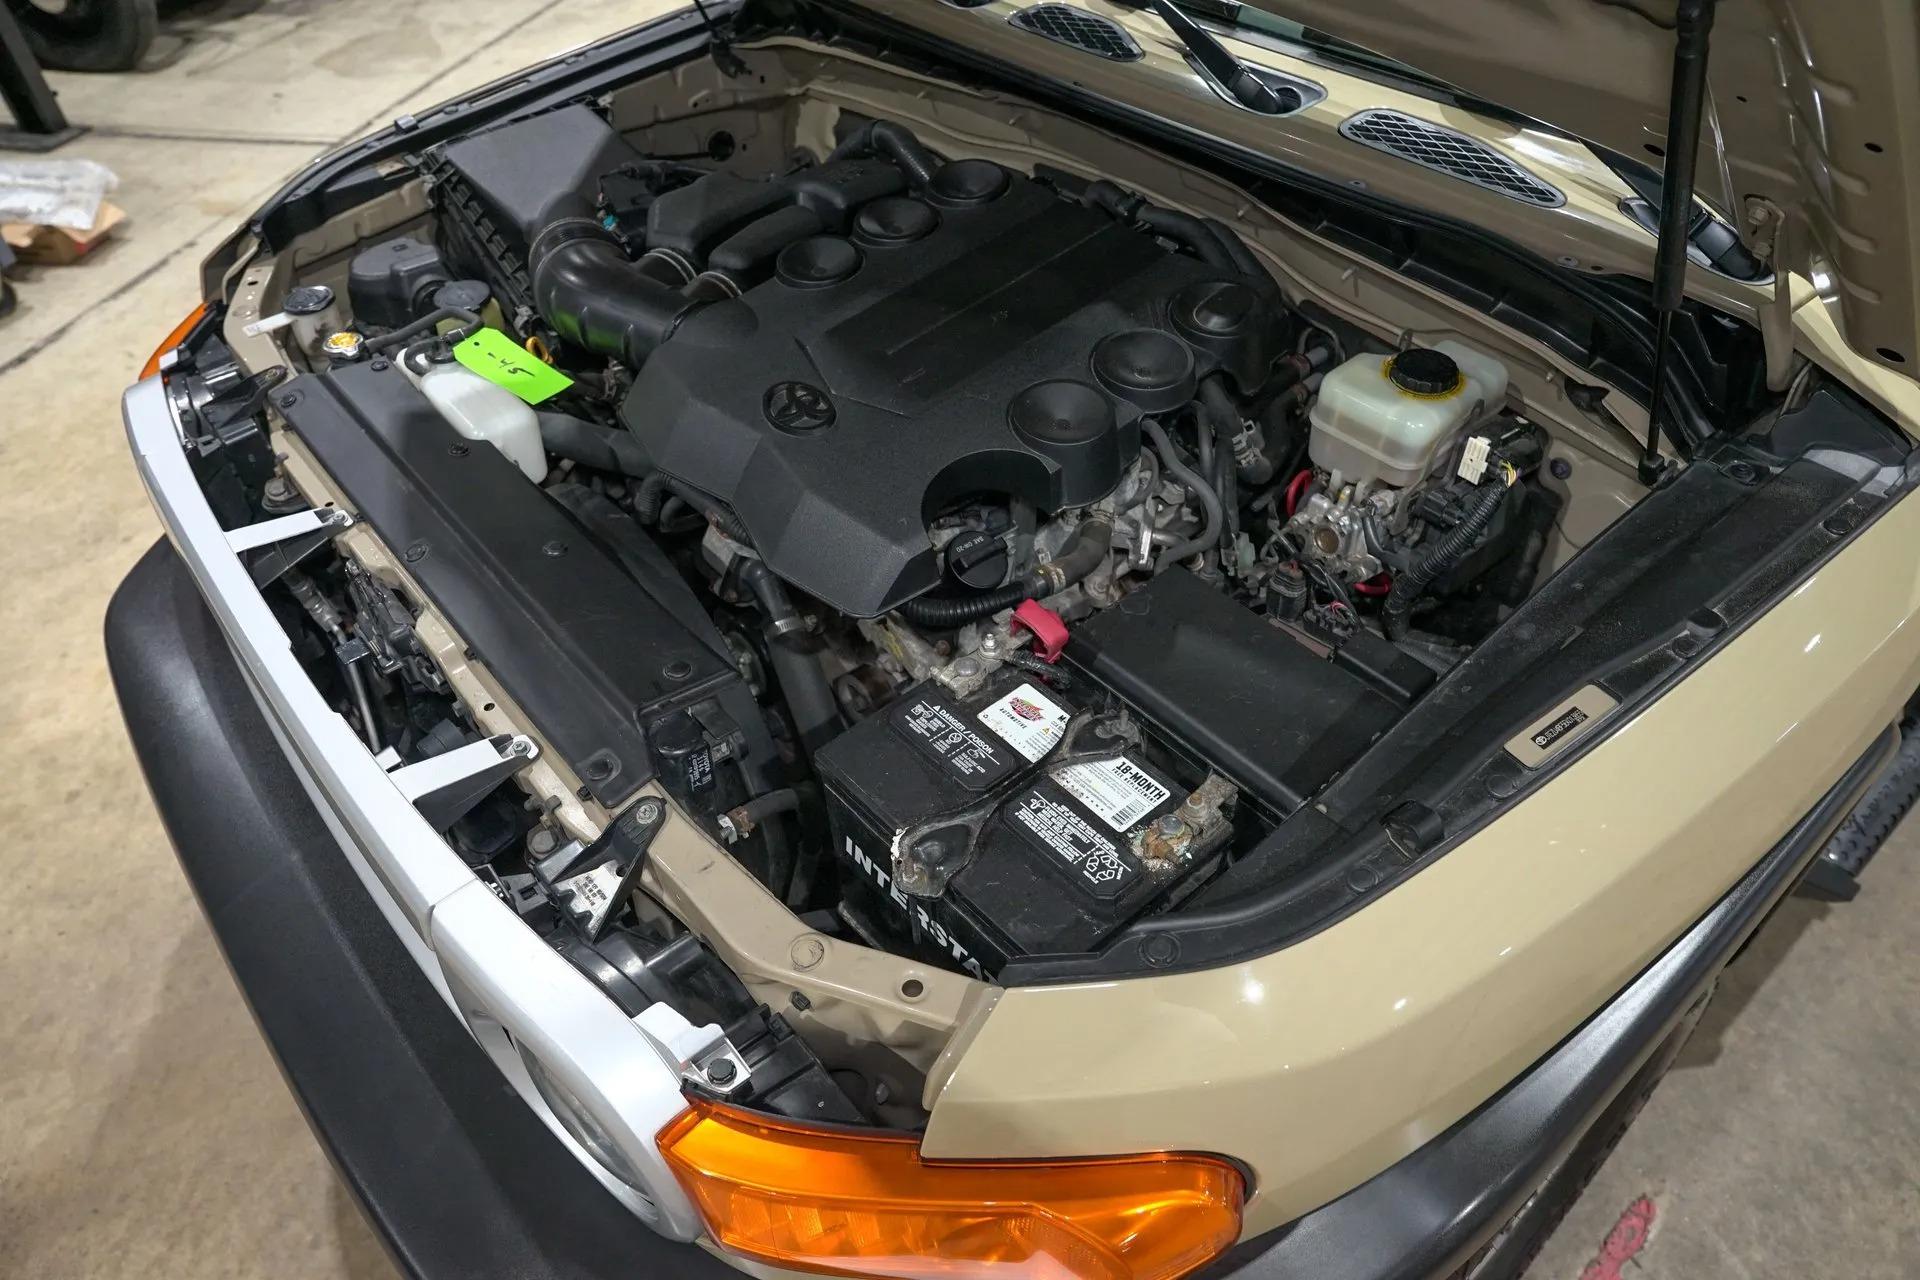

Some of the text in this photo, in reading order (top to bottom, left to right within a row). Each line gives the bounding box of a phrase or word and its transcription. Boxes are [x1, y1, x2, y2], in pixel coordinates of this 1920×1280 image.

[1000, 708, 1027, 729] AUTOMOTIVE
[940, 710, 966, 732] DANGER
[968, 733, 994, 754] POISON
[1116, 762, 1166, 800] 18-MONTH
[1124, 778, 1157, 803] REPLACEMENT
[1052, 825, 1063, 833] HELP
[1062, 833, 1073, 841] FAST
